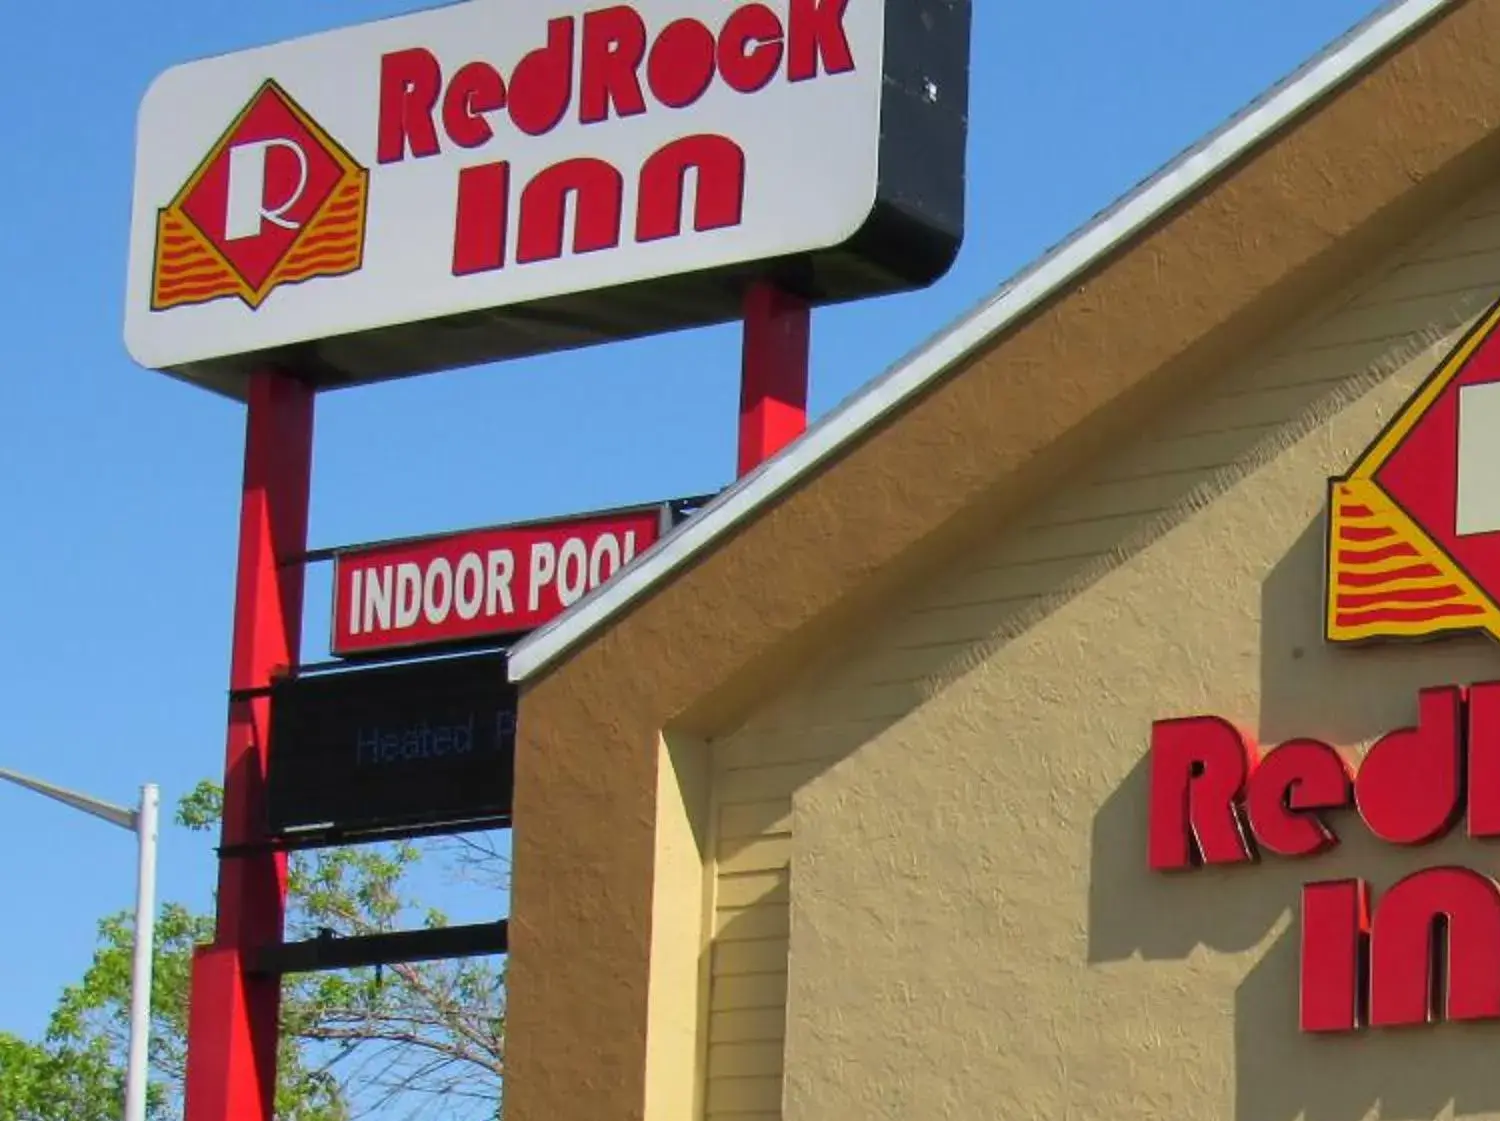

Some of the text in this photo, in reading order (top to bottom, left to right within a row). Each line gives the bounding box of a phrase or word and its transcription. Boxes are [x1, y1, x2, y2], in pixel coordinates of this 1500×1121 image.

[452, 134, 745, 276] Inn
[349, 549, 513, 634] INDOOR
[356, 711, 475, 766] Heated
